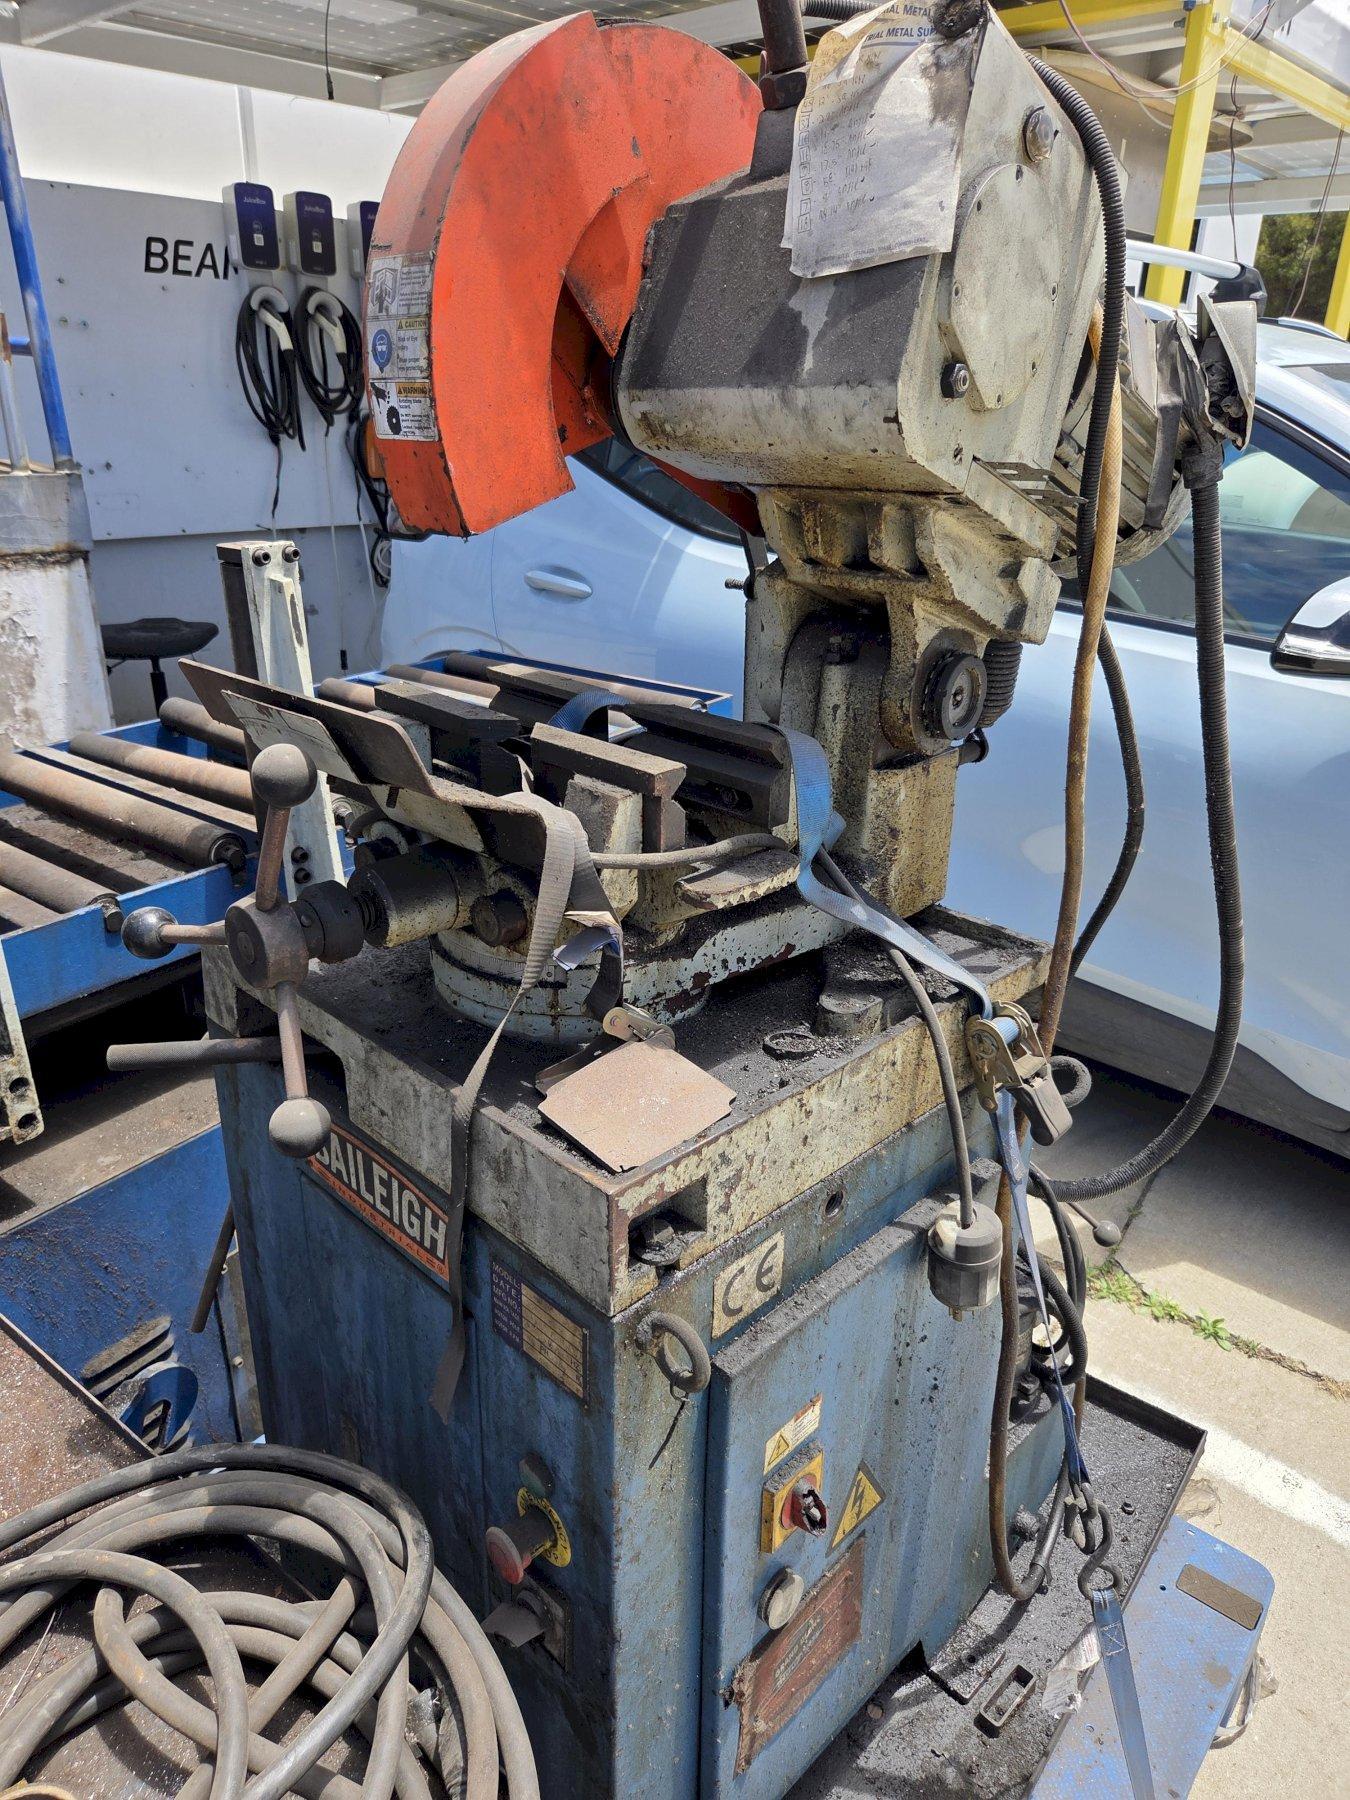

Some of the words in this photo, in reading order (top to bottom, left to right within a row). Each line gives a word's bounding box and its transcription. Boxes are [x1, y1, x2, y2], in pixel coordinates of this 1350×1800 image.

[903, 5, 931, 17] METAL
[886, 27, 914, 37] METAL
[405, 319, 427, 329] CAUTION
[403, 386, 427, 395] WARNING
